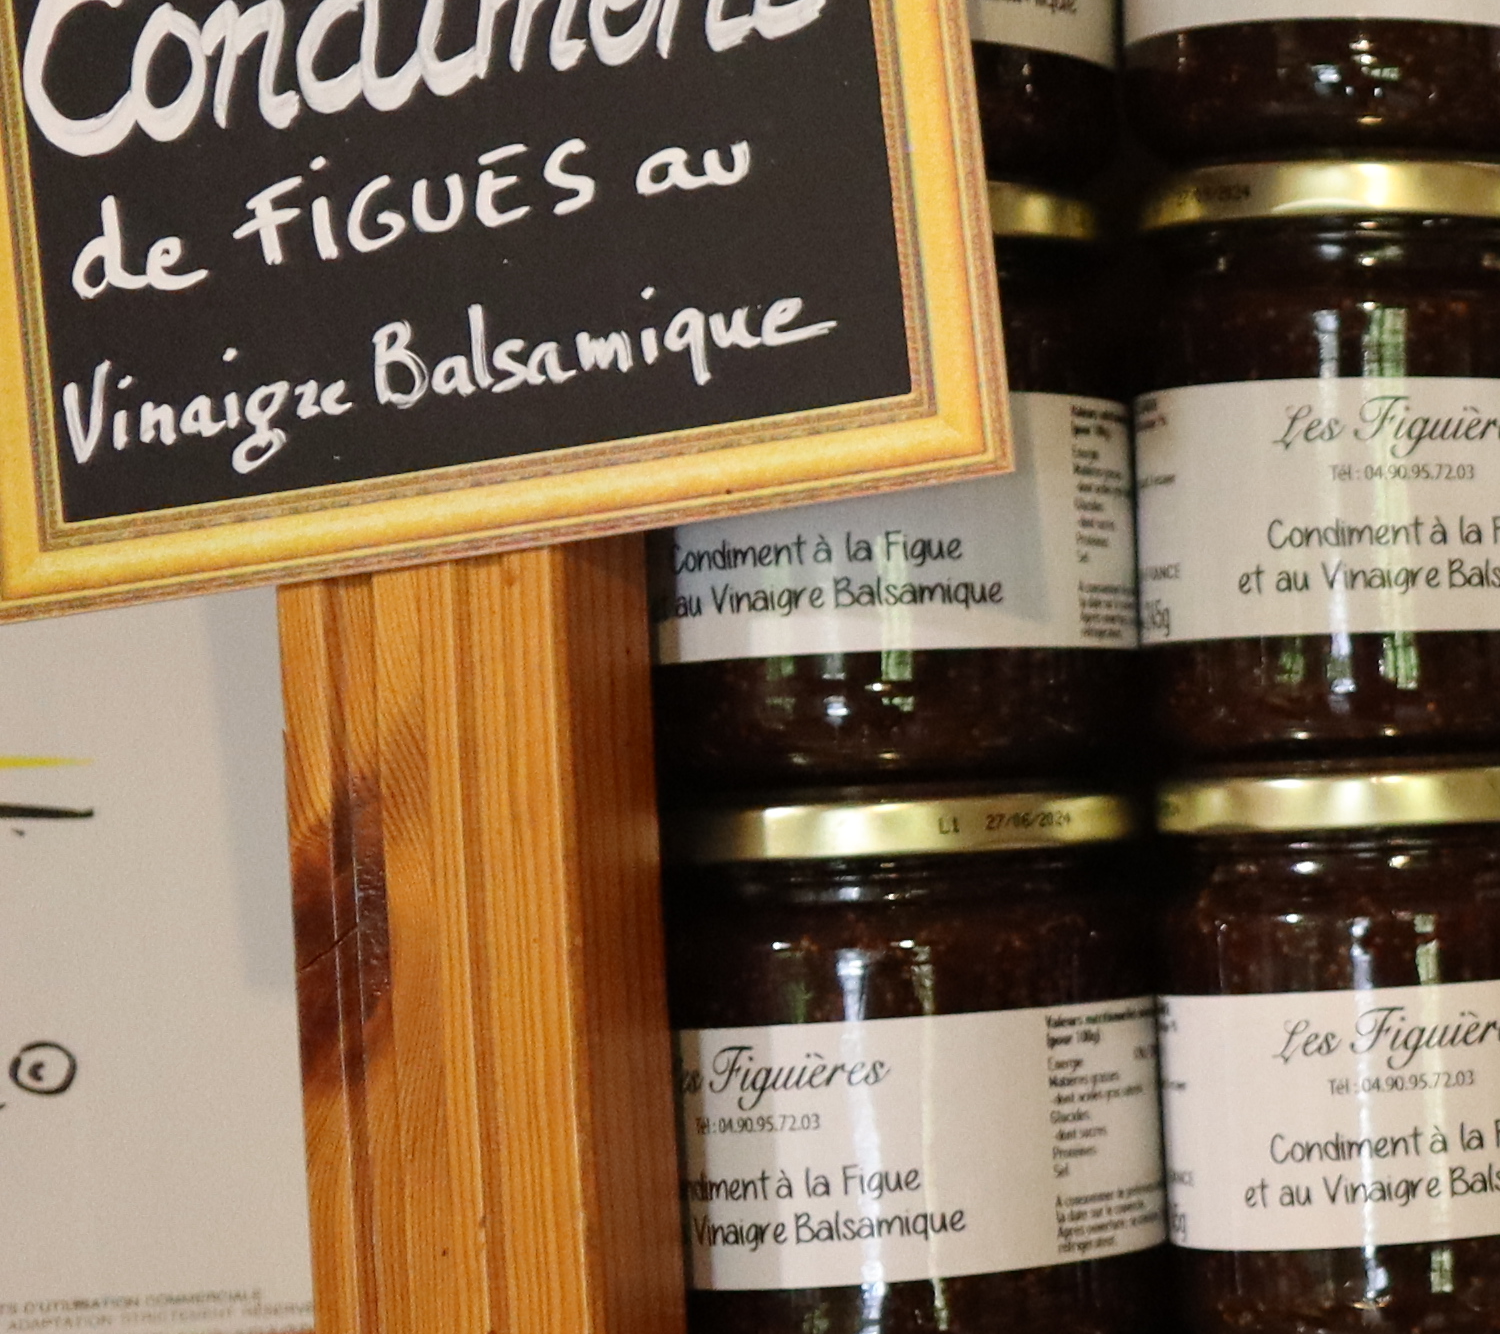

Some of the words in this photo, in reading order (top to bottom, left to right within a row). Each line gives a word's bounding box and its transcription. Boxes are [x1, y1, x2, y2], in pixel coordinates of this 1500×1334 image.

[71, 196, 209, 299] de
[636, 139, 751, 196] au
[64, 346, 353, 474] Vinaigre
[373, 286, 838, 409] Balsamique
[1272, 403, 1343, 451] Les
